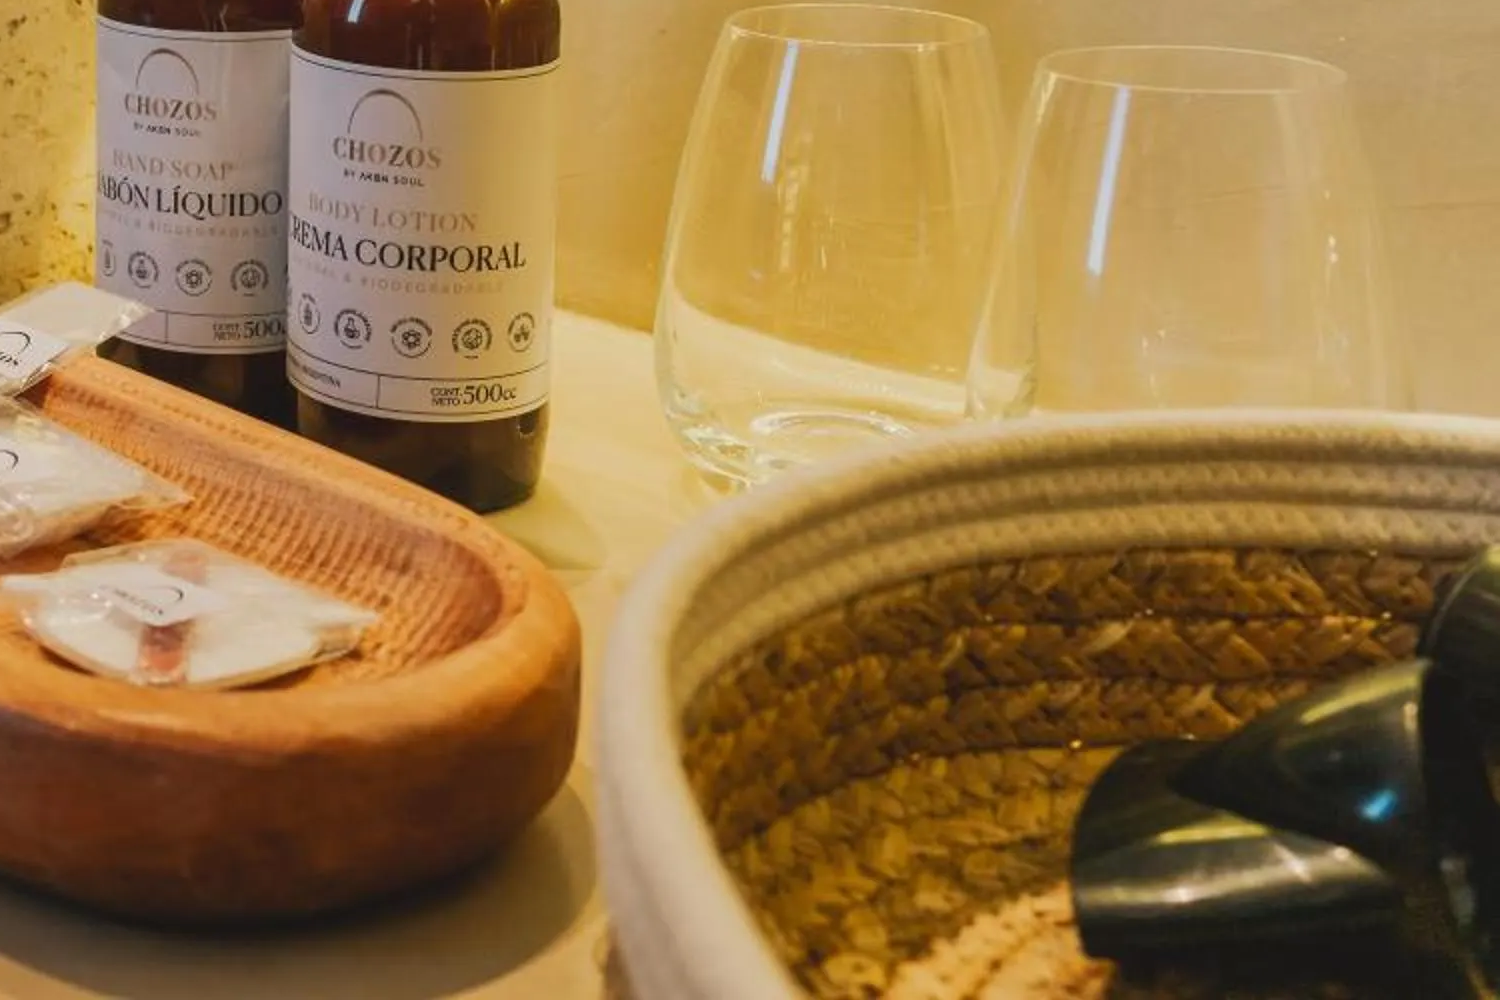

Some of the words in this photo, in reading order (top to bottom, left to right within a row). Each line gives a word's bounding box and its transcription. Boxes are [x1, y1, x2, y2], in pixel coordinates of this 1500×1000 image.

[124, 92, 217, 121] CHOZOS
[113, 148, 164, 175] HAND
[171, 160, 230, 182] SOAP
[332, 136, 442, 169] CHOZOS
[97, 171, 150, 210] ABÓN
[156, 181, 283, 221] LÍQUIDO
[309, 192, 368, 224] BODY
[372, 207, 477, 233] LOTION
[290, 215, 349, 262] REMA
[355, 239, 526, 273] CORPORAL
[462, 383, 517, 406] 500cc
